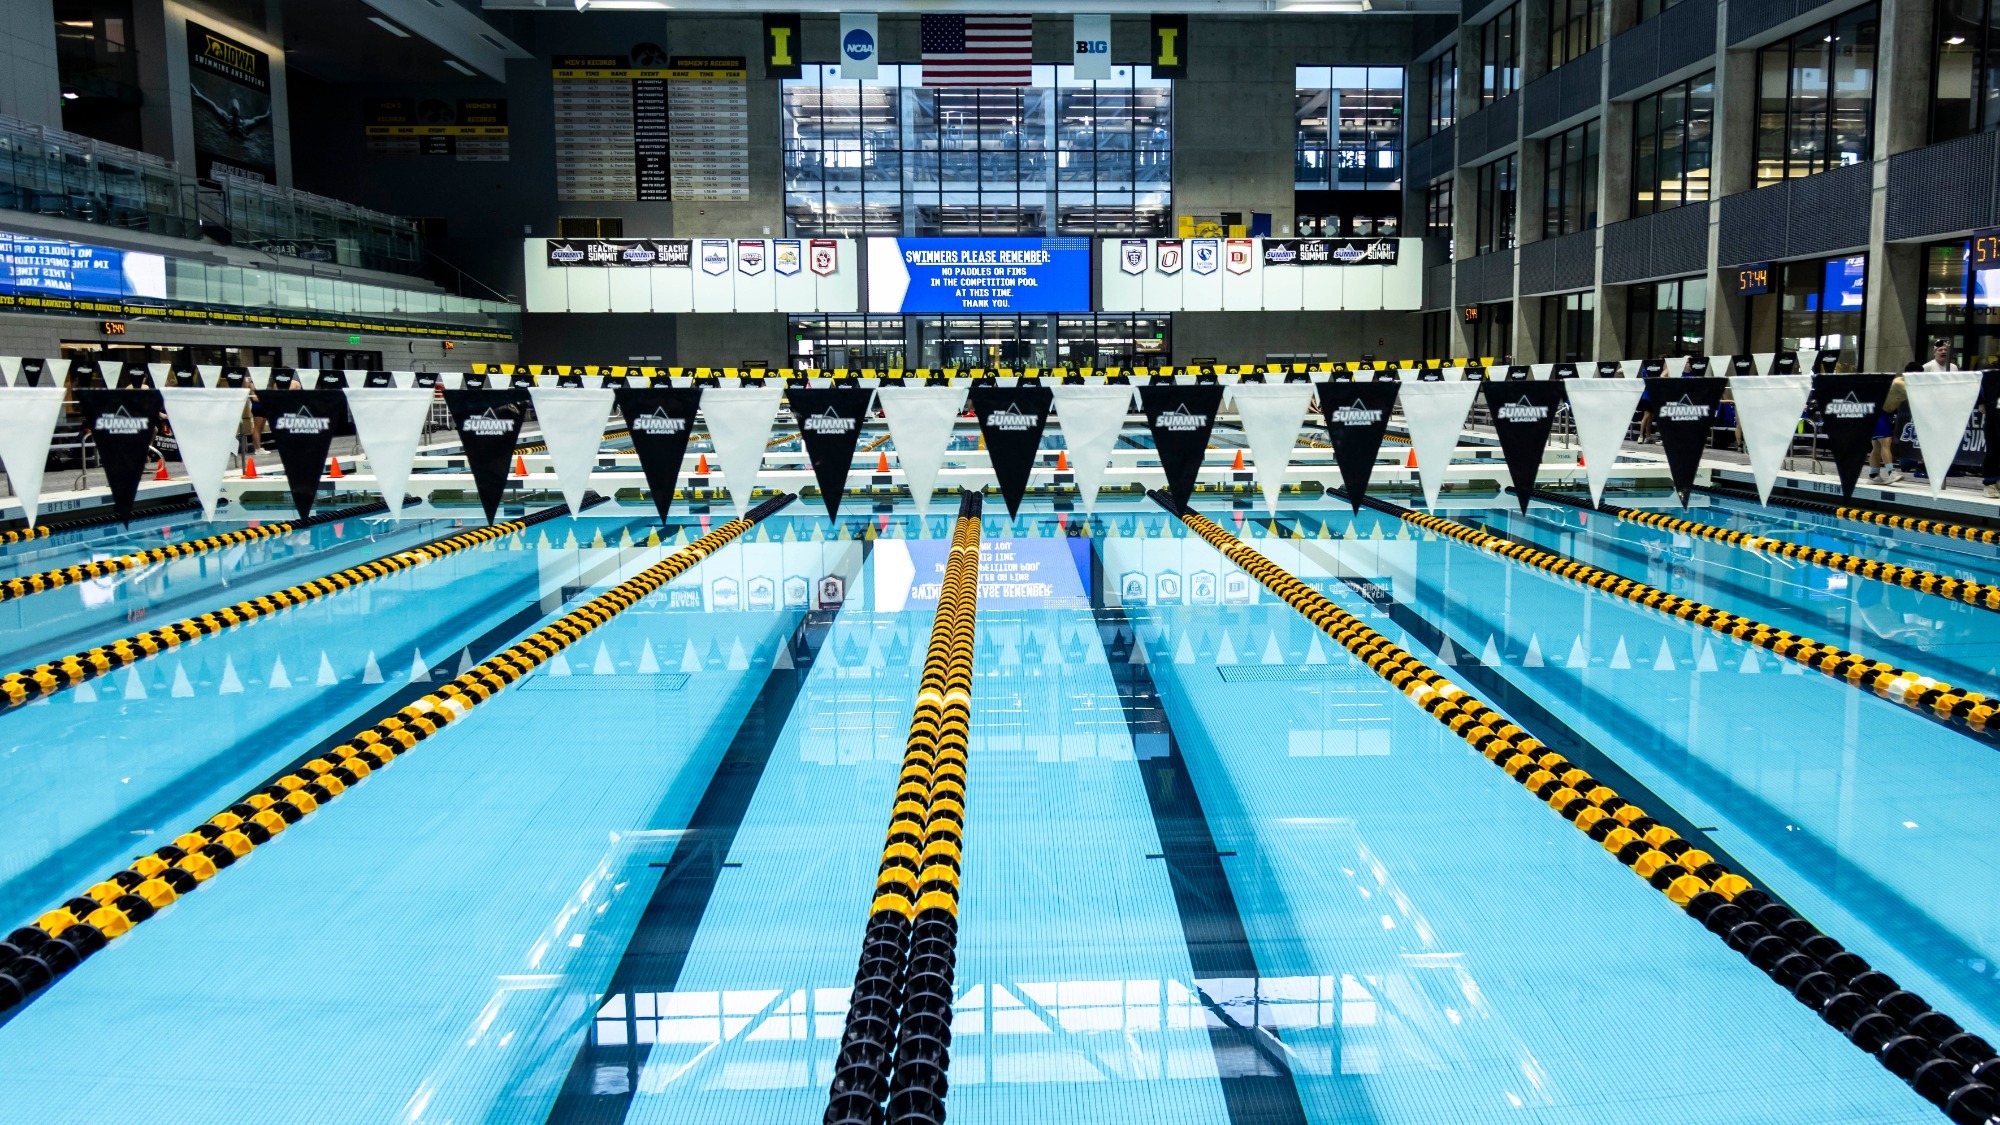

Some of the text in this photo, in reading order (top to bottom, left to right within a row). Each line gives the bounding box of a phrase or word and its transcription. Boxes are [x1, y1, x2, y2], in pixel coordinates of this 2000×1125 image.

[771, 28, 791, 65] I
[846, 44, 874, 53] NCAA
[1158, 28, 1178, 65] I
[224, 44, 254, 74] IOWA
[195, 54, 265, 88] SWIMMING AND DIVING
[588, 245, 613, 253] REACH
[658, 245, 684, 253] REACH
[1300, 244, 1324, 252] REACH
[588, 253, 618, 262] SUMMIT
[658, 253, 689, 262] SUMMIT
[906, 251, 1051, 263] SWIMMERS PLEASE REMEMBER:
[1300, 252, 1328, 261] SUMMIT
[1368, 252, 1396, 260] SUMMIT
[942, 268, 1027, 276] NO PADDLES OR FINS
[931, 278, 1038, 287] IN THE COMPETITION POOL
[1740, 270, 1767, 290] 57:44
[956, 289, 1014, 297] AT THIS TIME.
[25, 298, 72, 309] IOWA HAWKEYES
[81, 302, 122, 313] IOWA HAWKEYES
[962, 300, 1010, 308] THANK YOU.
[142, 307, 166, 316] HAWKEYES
[106, 322, 125, 335] 57:44
[1498, 407, 1549, 419] SUMMIT
[1660, 406, 1710, 418] SUMMIT
[1825, 403, 1875, 415] SUMMIT
[986, 415, 1038, 427] SUMMIT
[1156, 415, 1207, 427] SUMMIT
[1332, 410, 1383, 422] SUMMIT
[95, 418, 149, 429] SUMMIT
[276, 418, 330, 429] SUMMIT
[463, 420, 515, 431] SUMMIT
[633, 418, 686, 430] SUMMIT
[804, 418, 856, 430] SUMMIT
